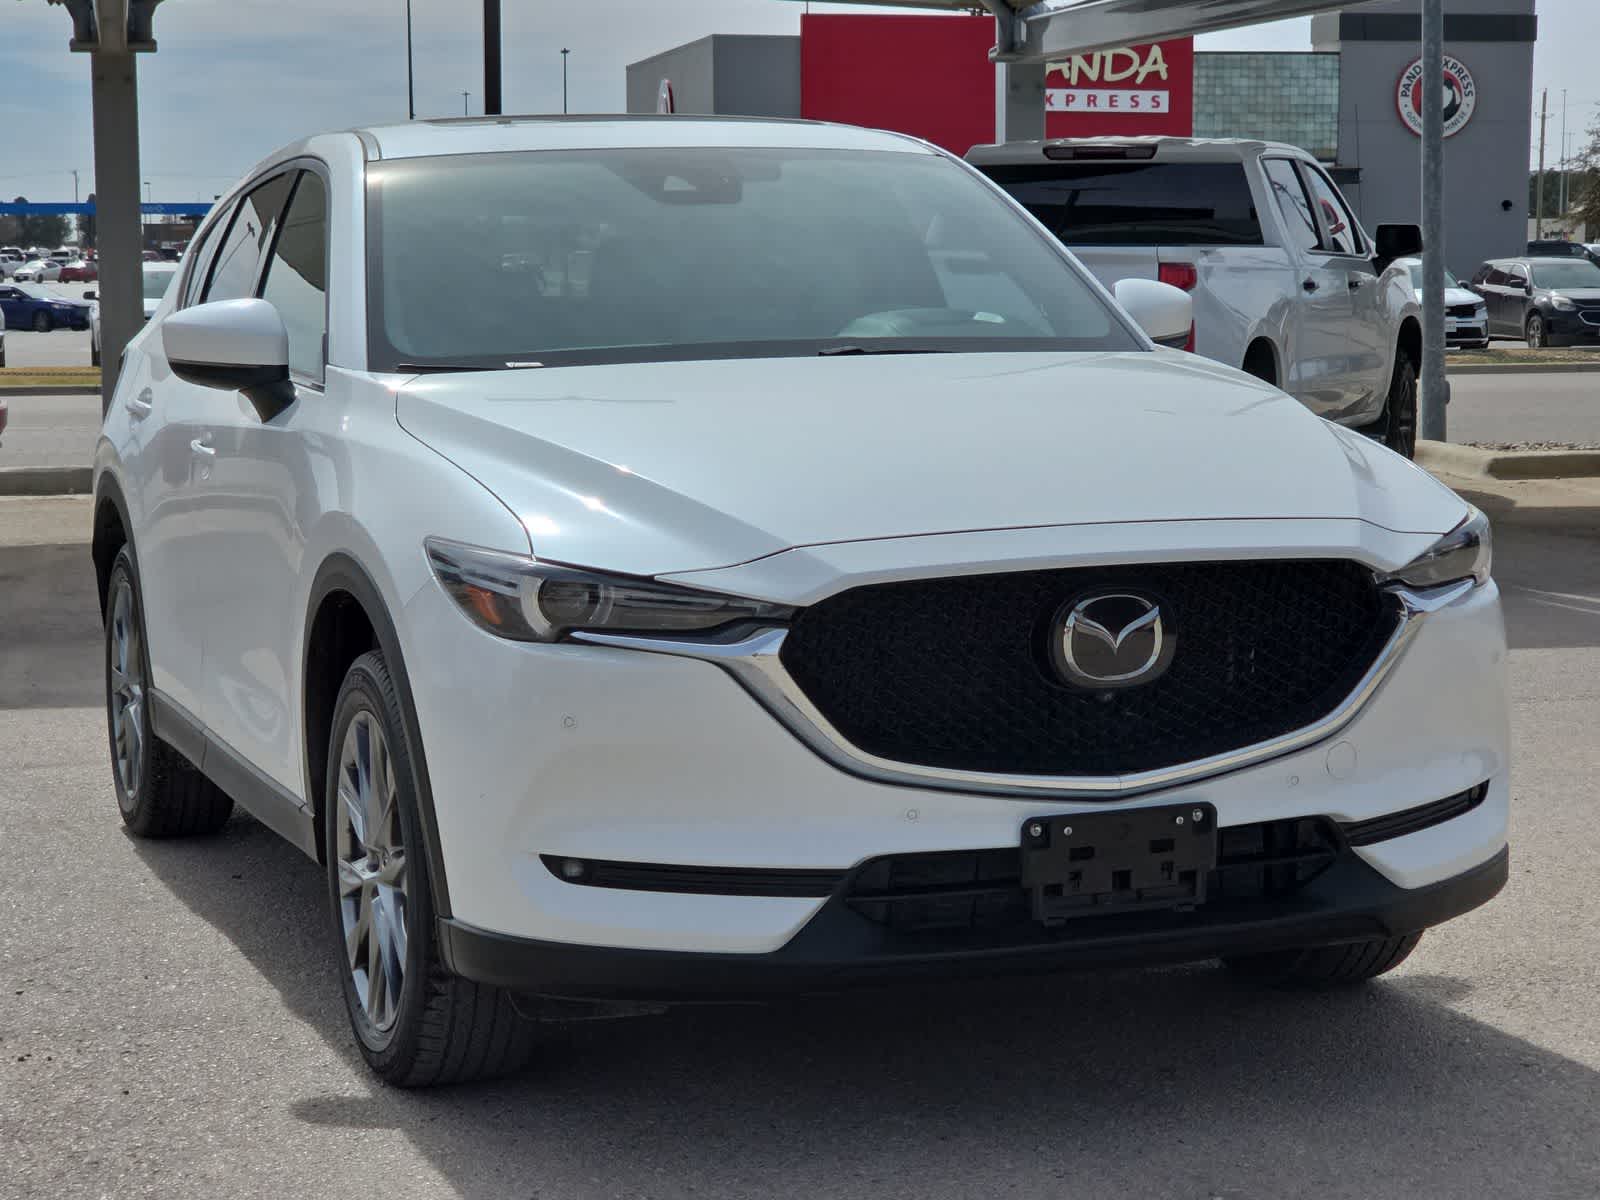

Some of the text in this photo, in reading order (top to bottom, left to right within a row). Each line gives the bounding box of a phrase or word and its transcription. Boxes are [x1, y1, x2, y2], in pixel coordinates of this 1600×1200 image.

[1046, 45, 1169, 86] ANDA
[1401, 58, 1473, 97] PAND XPRESS
[1046, 92, 1162, 109] XPRESS
